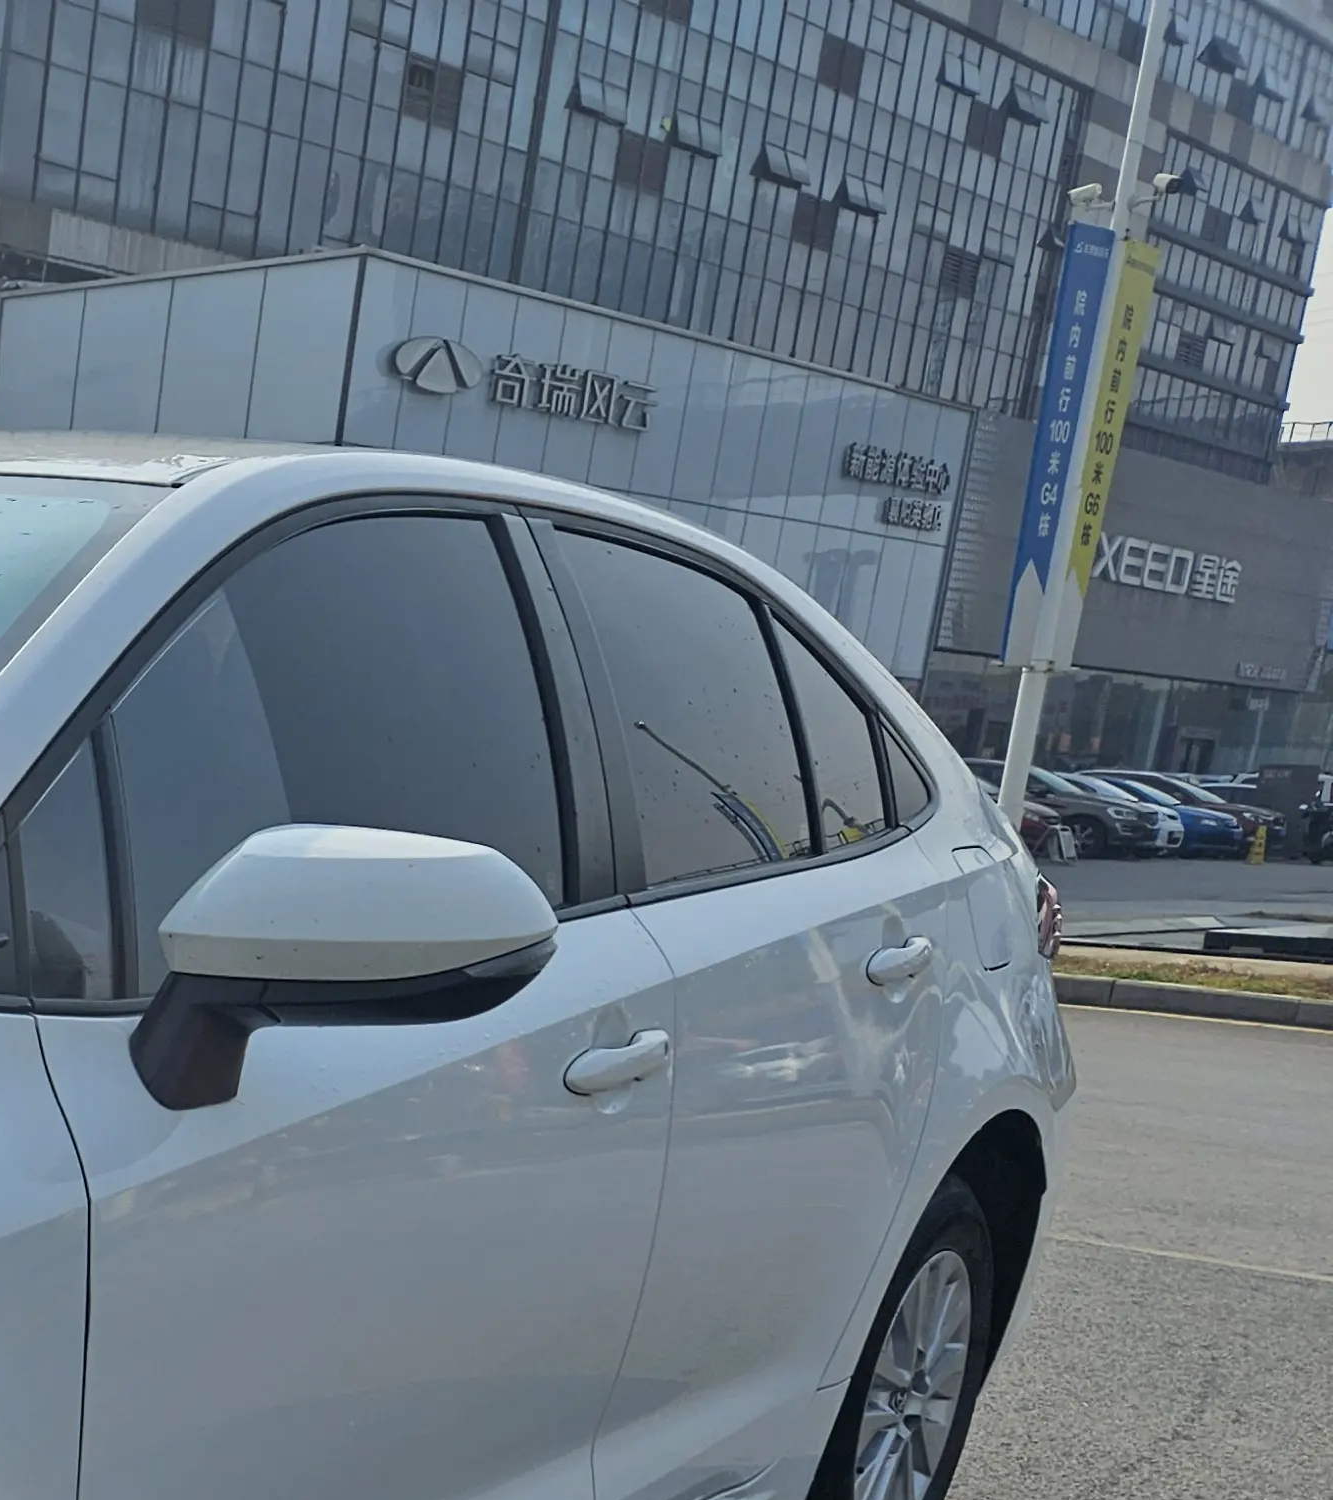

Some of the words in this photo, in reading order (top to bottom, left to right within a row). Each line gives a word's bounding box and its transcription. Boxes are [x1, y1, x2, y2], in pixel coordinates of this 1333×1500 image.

[489, 353, 659, 433] 奇瑞风云
[1037, 289, 1088, 538] 院内前行100米G4栋
[1080, 303, 1134, 547] 院内前行100米G6栋
[1092, 531, 1195, 595] XEED
[1190, 553, 1243, 604] 星途
